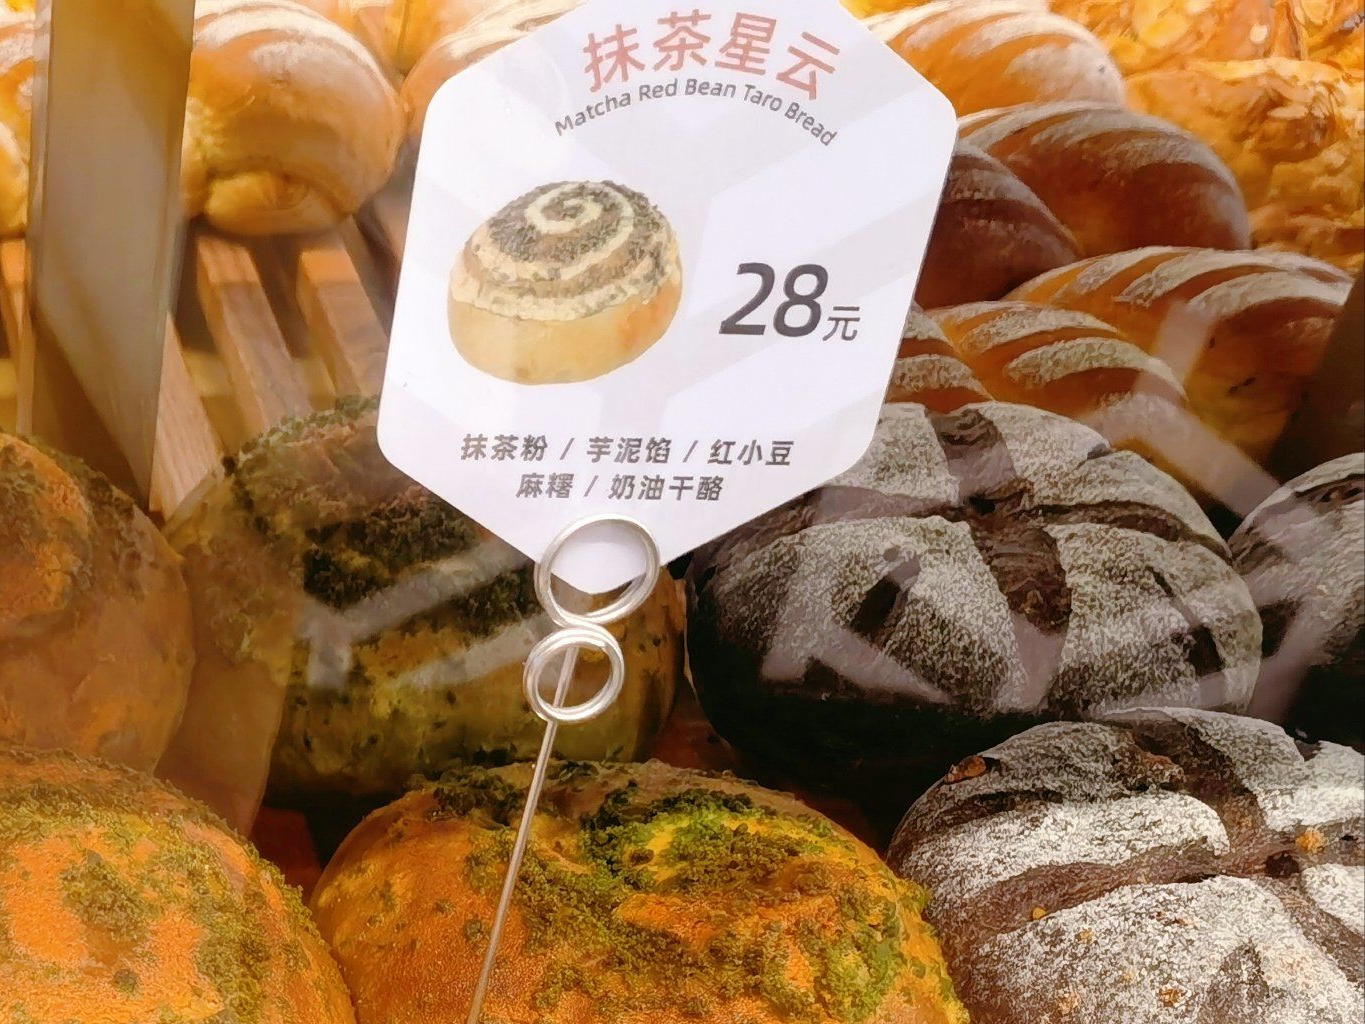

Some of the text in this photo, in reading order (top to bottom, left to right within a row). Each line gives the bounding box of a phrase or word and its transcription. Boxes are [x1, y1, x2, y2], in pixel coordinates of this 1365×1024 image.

[582, 9, 840, 101] 抹茶星云
[554, 78, 837, 146] Matcha Red Bean Taro Bread
[460, 433, 548, 461] 抹茶粉
[586, 437, 671, 463] 芋泥馅
[707, 439, 794, 466] 红小豆
[607, 474, 724, 501] 奶油干酪
